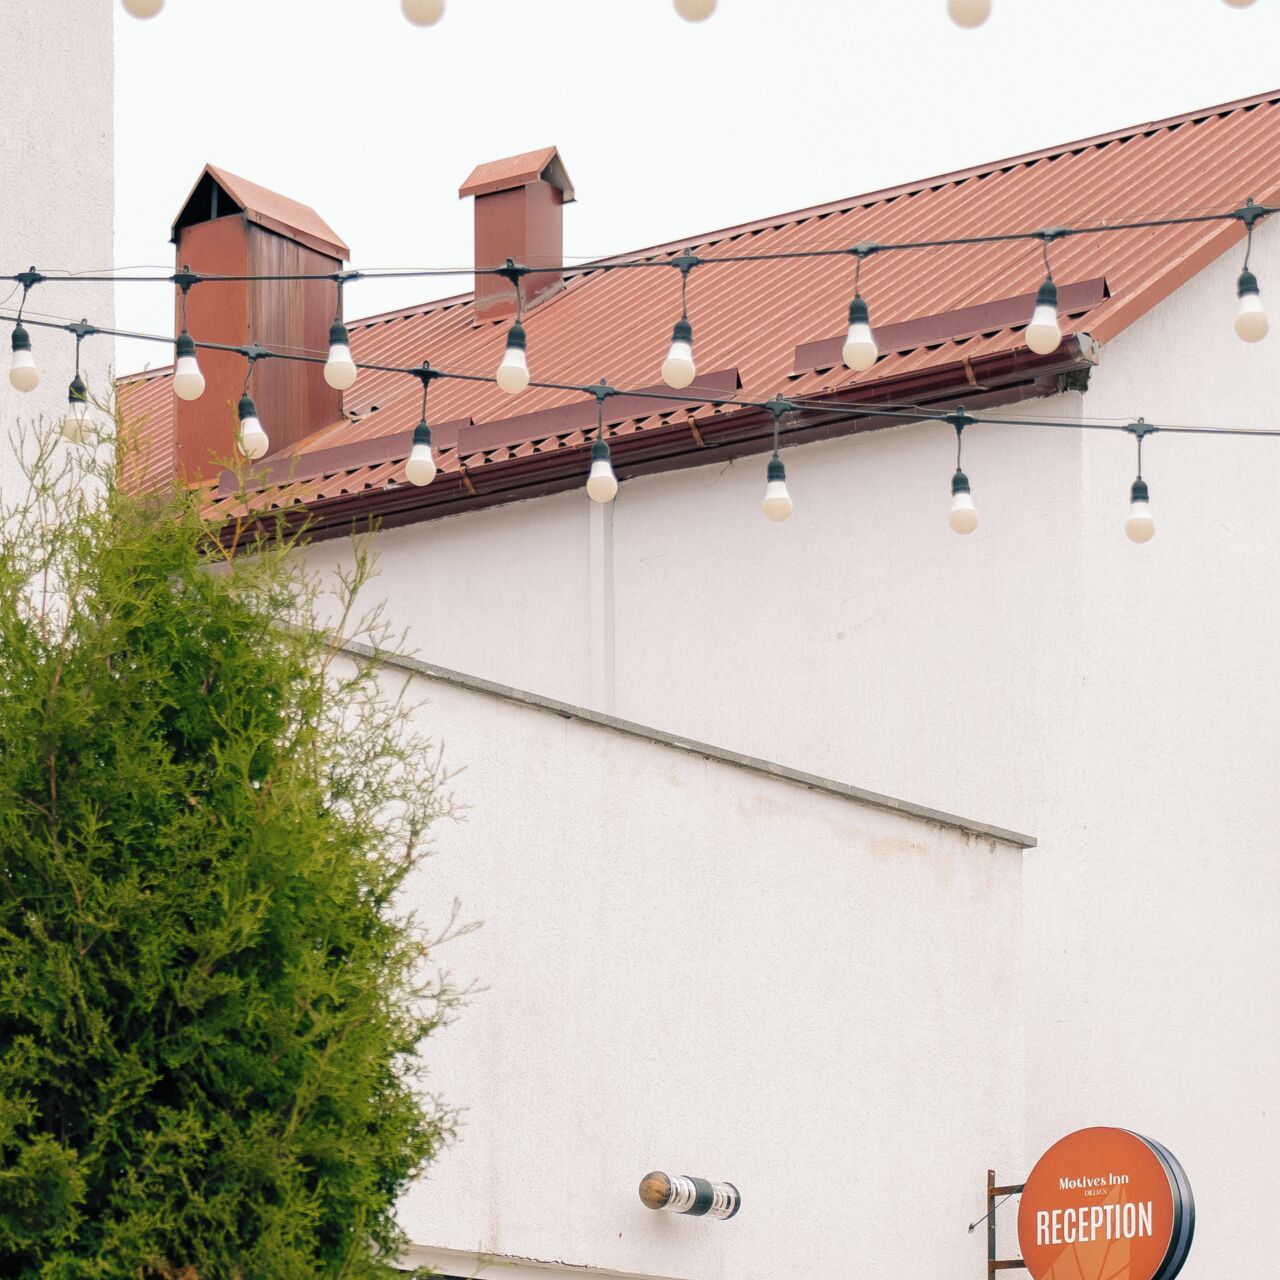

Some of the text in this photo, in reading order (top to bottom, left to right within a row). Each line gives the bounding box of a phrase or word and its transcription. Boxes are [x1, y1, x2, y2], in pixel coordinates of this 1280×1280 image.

[1059, 1173, 1129, 1190] Motives Inn
[1036, 1201, 1153, 1246] RECEPTION
